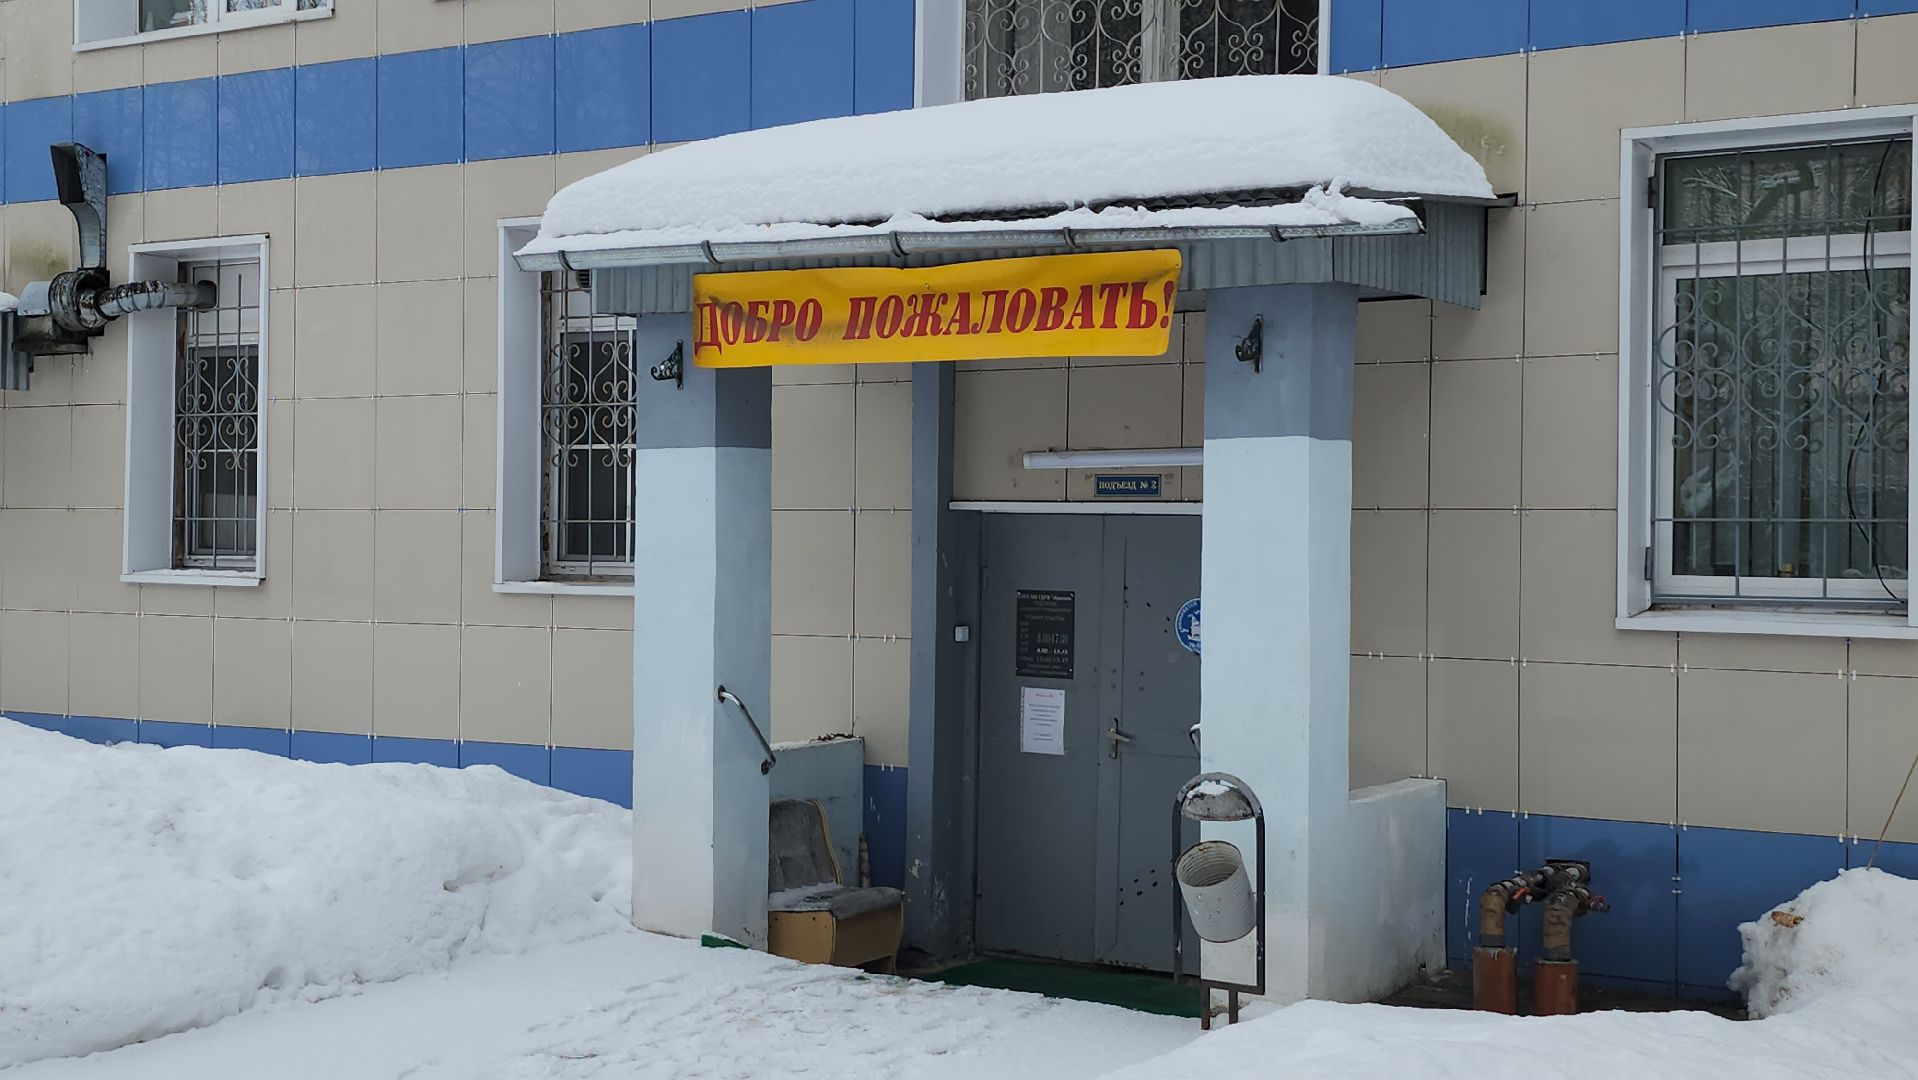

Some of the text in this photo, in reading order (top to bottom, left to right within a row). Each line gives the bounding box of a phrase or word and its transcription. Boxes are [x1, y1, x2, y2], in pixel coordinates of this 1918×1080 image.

[694, 280, 1175, 355] ДОБРО ПОЖАЛОВАТЬ!
[1098, 480, 1157, 491] ПОДЪЕЗД № 2
